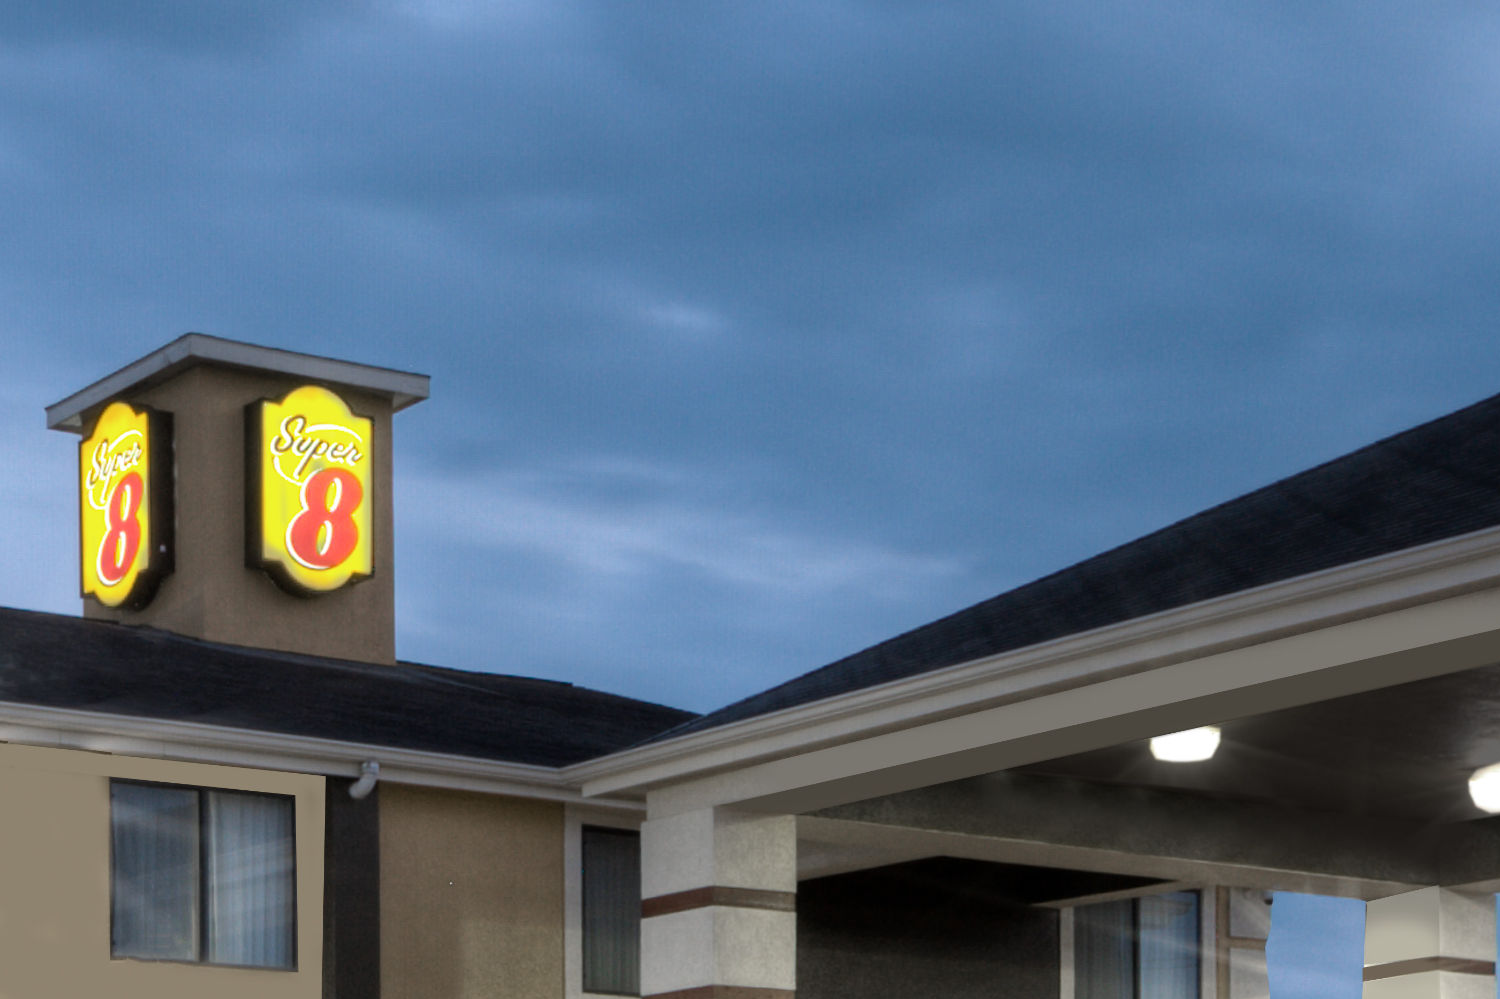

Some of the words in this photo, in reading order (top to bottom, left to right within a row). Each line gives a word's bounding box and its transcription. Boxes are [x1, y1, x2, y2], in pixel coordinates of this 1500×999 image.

[85, 437, 144, 504] Super
[270, 414, 364, 480] Super
[96, 469, 144, 586] 8
[285, 466, 364, 571] 8
